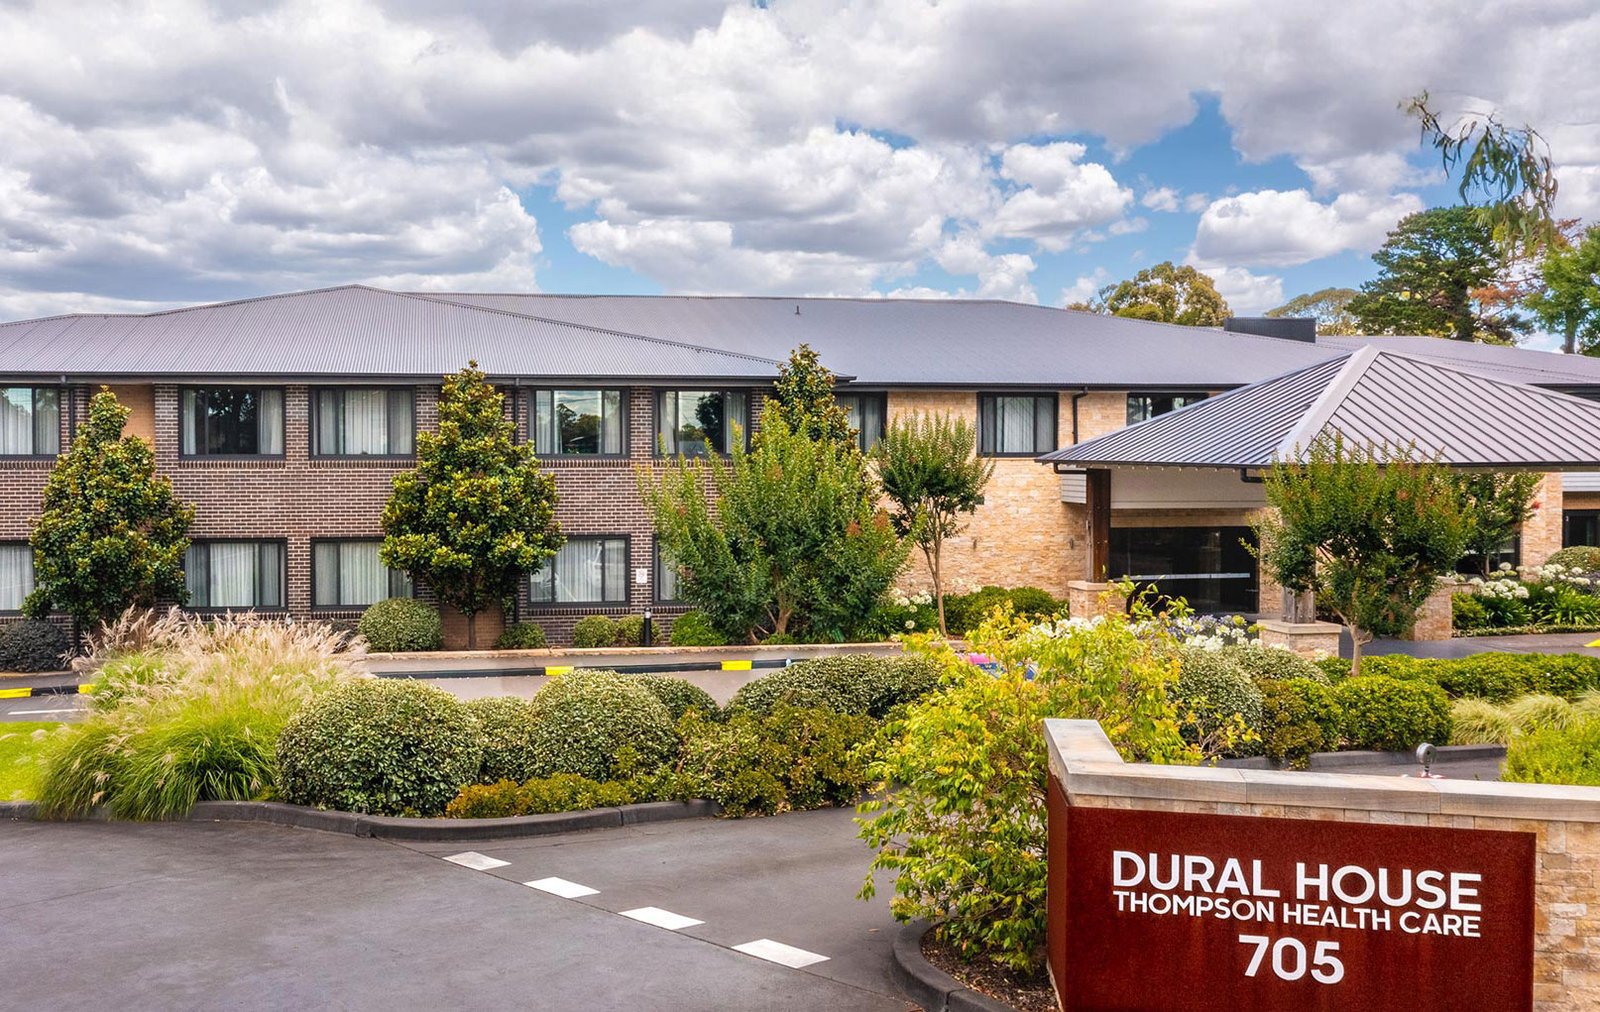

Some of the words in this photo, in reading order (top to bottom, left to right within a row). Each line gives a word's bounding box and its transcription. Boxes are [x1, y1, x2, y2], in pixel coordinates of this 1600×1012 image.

[1112, 850, 1281, 898] DURAL
[1295, 862, 1482, 912] HOUSE
[1112, 890, 1275, 922] THOMPSON
[1283, 902, 1391, 931] HEALTH
[1399, 911, 1481, 938] CARE
[1238, 934, 1345, 985] 705
